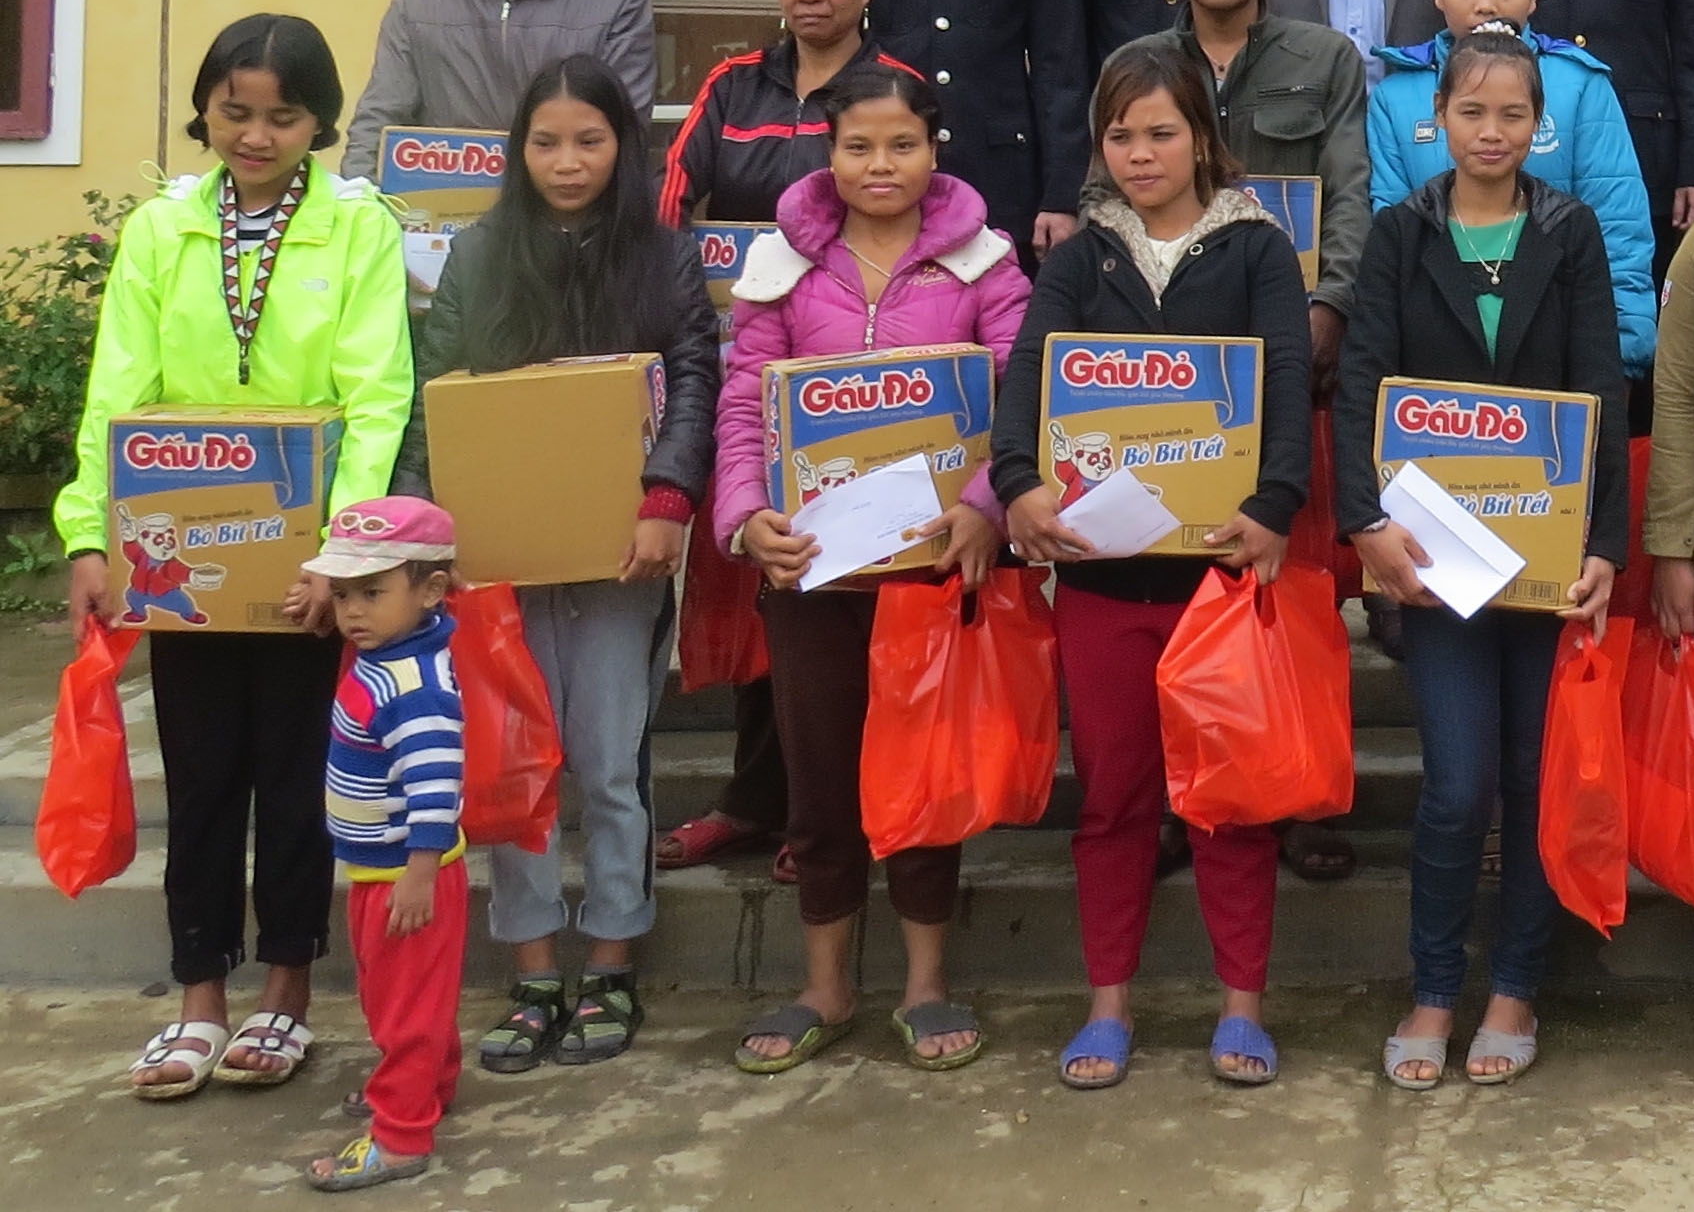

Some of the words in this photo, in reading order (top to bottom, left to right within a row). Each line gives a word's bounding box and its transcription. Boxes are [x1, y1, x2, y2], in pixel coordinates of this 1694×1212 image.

[392, 137, 461, 173] Gấu
[702, 234, 738, 268] Đỏ
[1060, 348, 1142, 388] Gấu
[1143, 350, 1197, 389] Đỏ
[800, 373, 880, 416] Gấu
[880, 368, 934, 409] Đỏ
[1394, 394, 1474, 436] Gấu
[1474, 402, 1527, 443] Đỏ
[124, 431, 201, 470] Gấu
[201, 433, 256, 471] Đỏ
[933, 443, 966, 474] Tết
[1123, 444, 1150, 468] Bò
[1191, 434, 1226, 463] Tết
[1518, 490, 1552, 516] Tết
[252, 514, 287, 541] Tết
